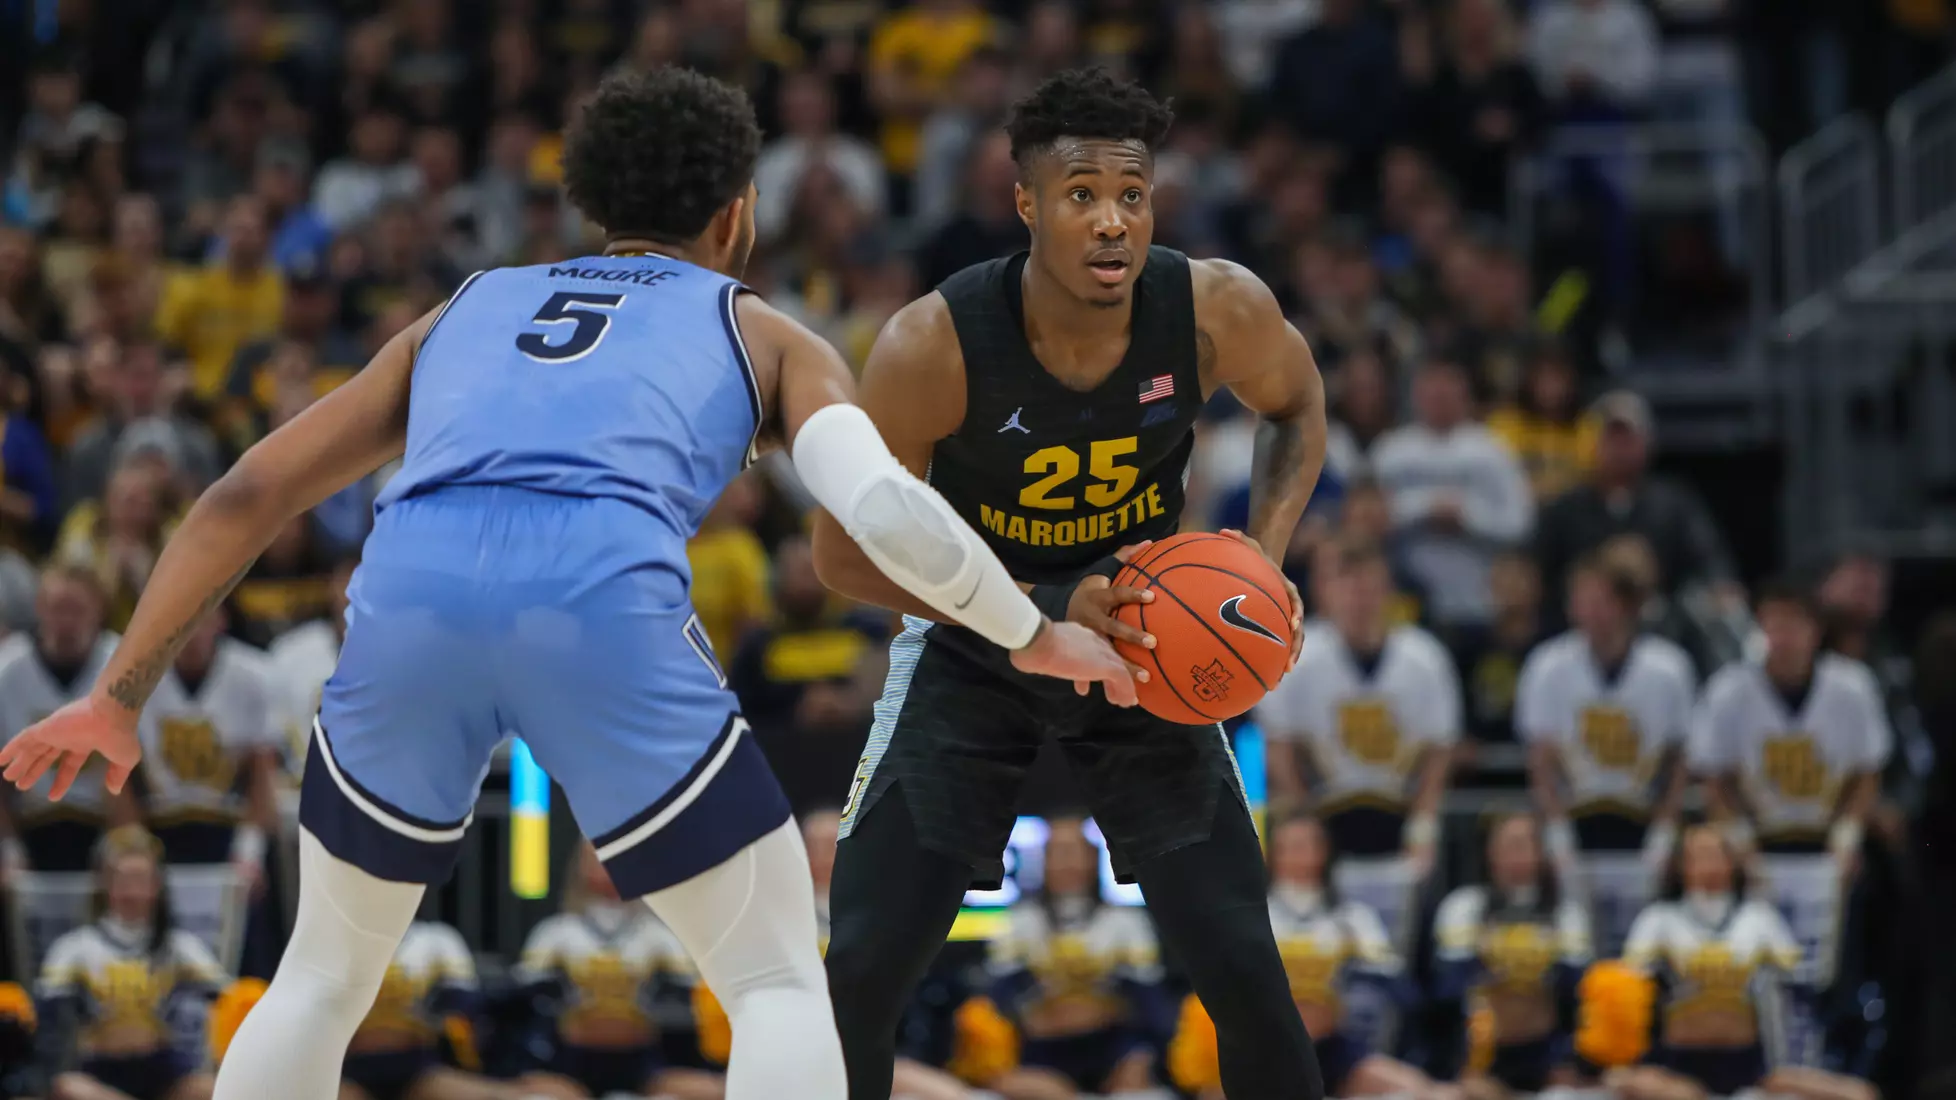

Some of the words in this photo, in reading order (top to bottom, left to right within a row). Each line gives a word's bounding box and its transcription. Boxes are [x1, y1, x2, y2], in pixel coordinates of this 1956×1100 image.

[548, 267, 680, 286] MOORE
[515, 291, 627, 364] 5
[1018, 435, 1139, 510] 25
[980, 482, 1165, 546] MARQUETTE
